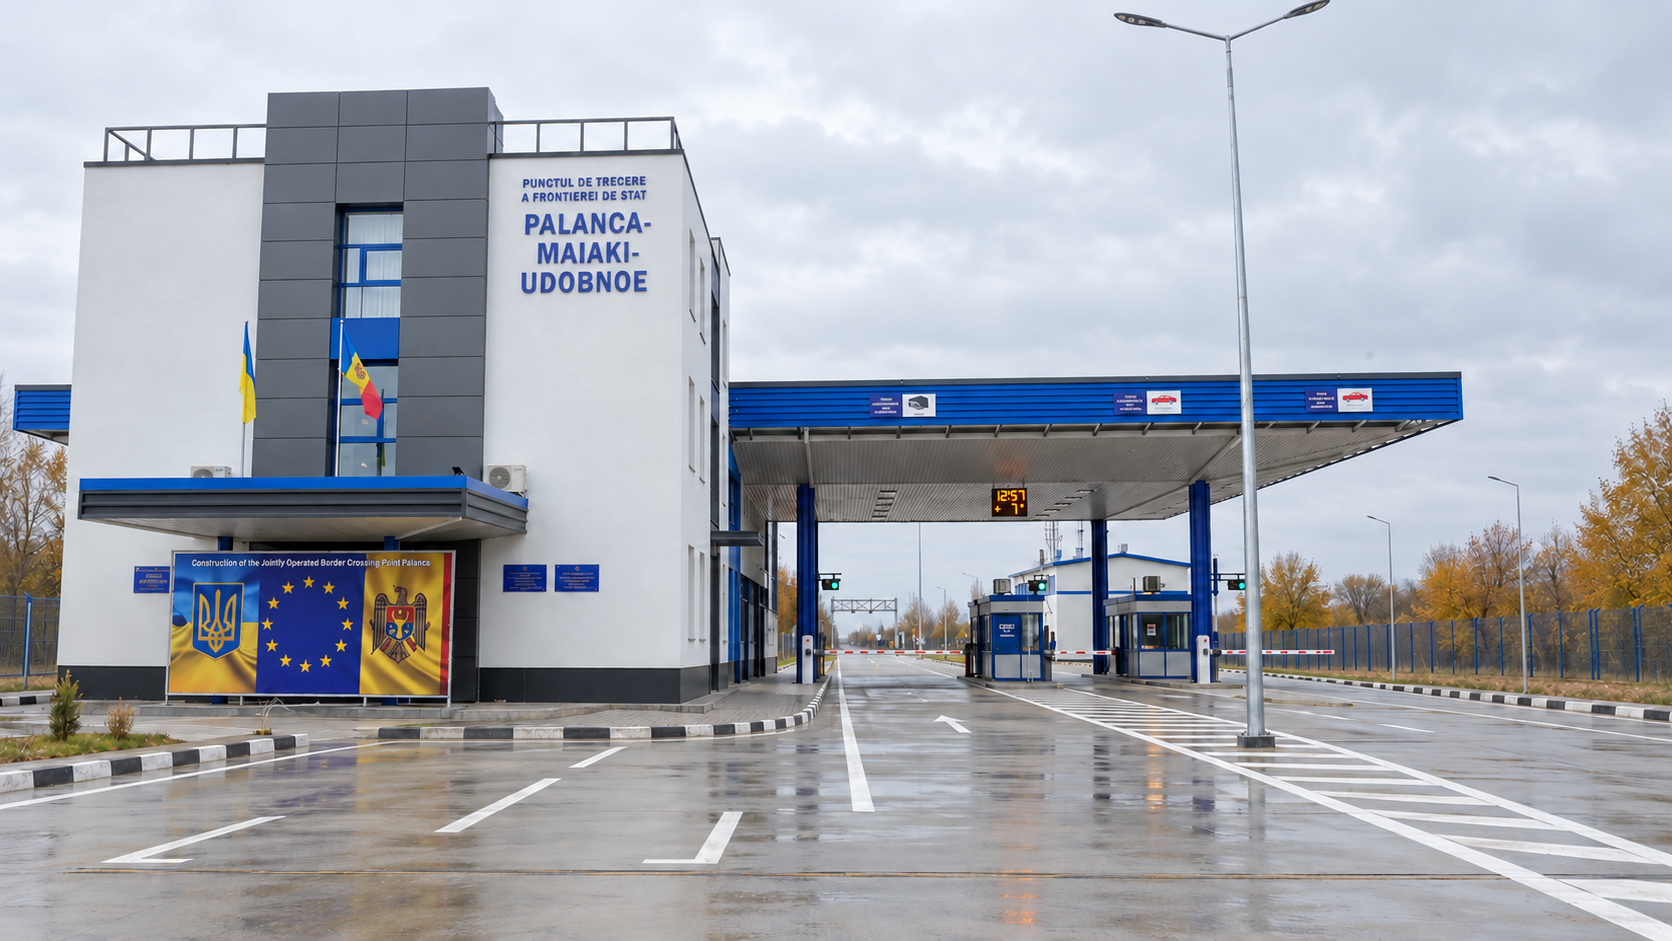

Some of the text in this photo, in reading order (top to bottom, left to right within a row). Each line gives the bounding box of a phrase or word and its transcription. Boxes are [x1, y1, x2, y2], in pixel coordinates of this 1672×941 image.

[522, 176, 646, 188] PUNCTUL DE TRECERE
[521, 190, 647, 202] A FRONTIEREI DE STAT
[524, 212, 651, 235] PALANCA-
[537, 241, 640, 264] MAIAKI-
[521, 270, 648, 294] UDOBNOE
[997, 490, 1026, 502] 12:57
[191, 558, 431, 569] Construction of the Jointly Operated Border Crossing Point Palanca
